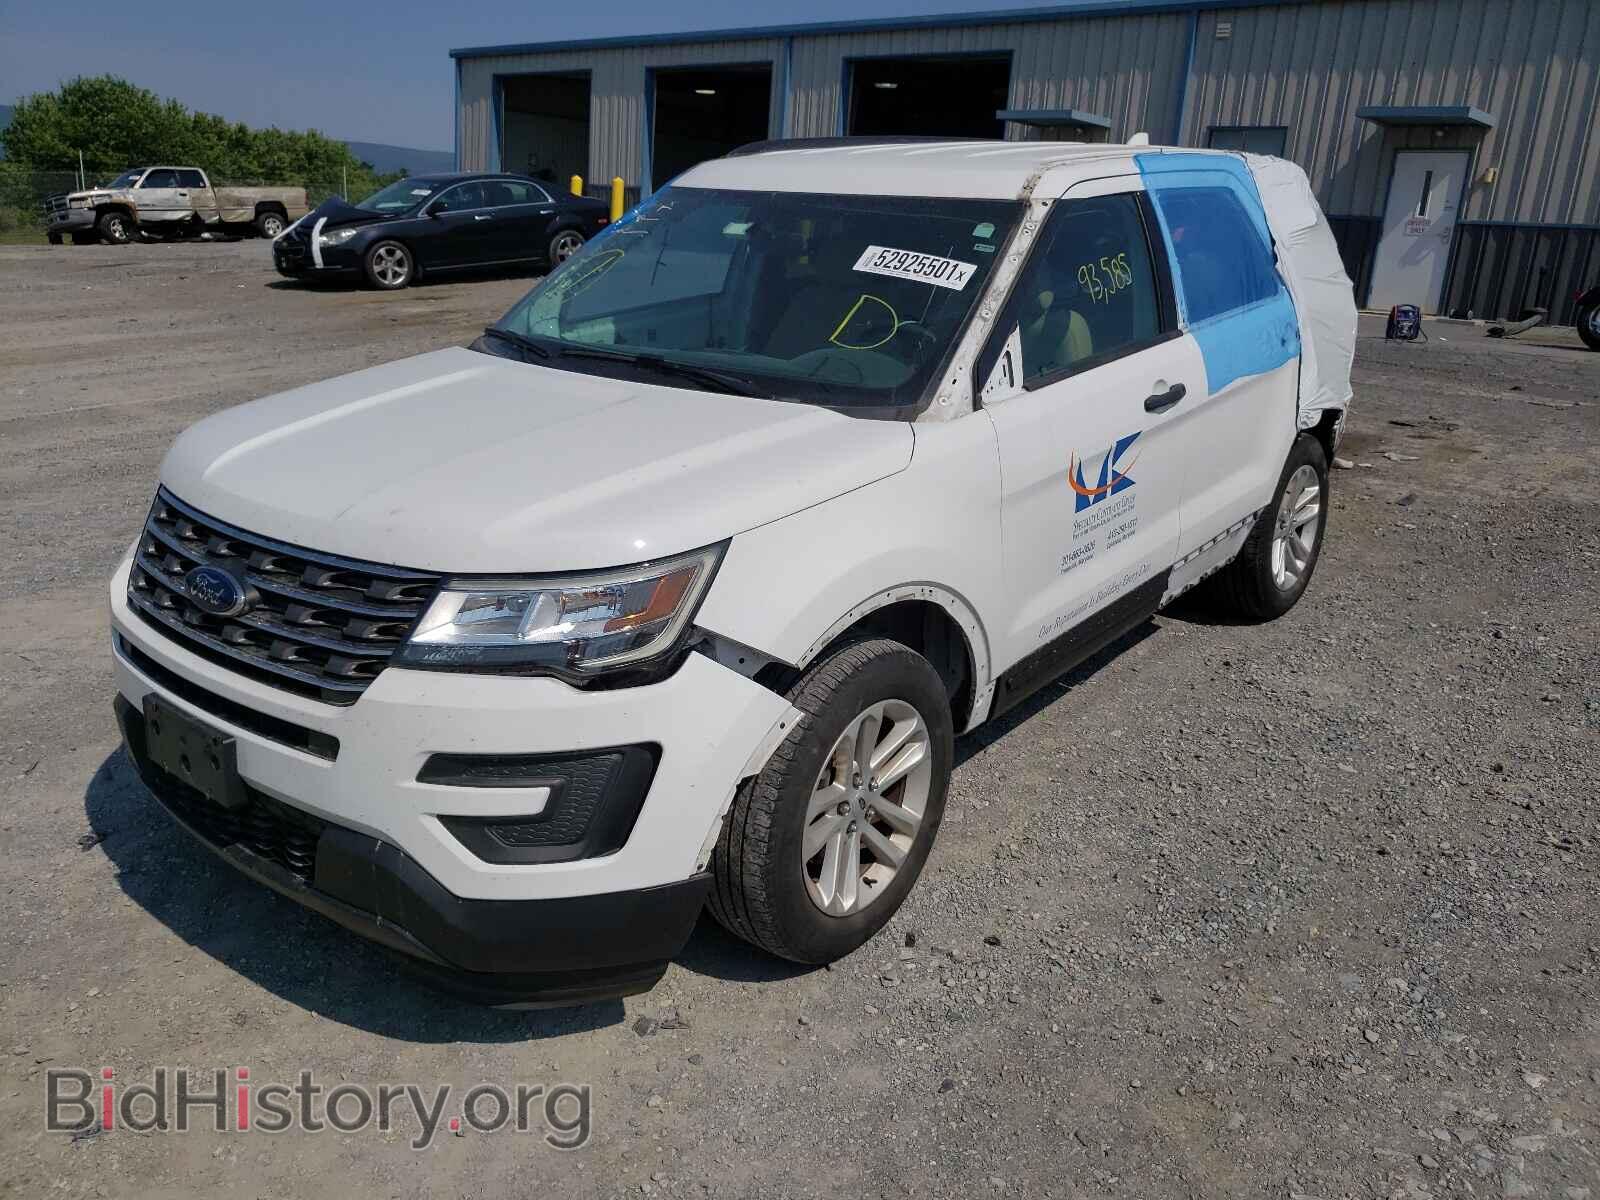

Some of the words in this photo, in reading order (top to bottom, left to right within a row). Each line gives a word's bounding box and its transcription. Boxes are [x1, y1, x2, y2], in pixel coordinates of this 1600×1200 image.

[873, 249, 960, 281] 52925501
[1078, 253, 1133, 305] 93,585
[828, 294, 898, 350] D
